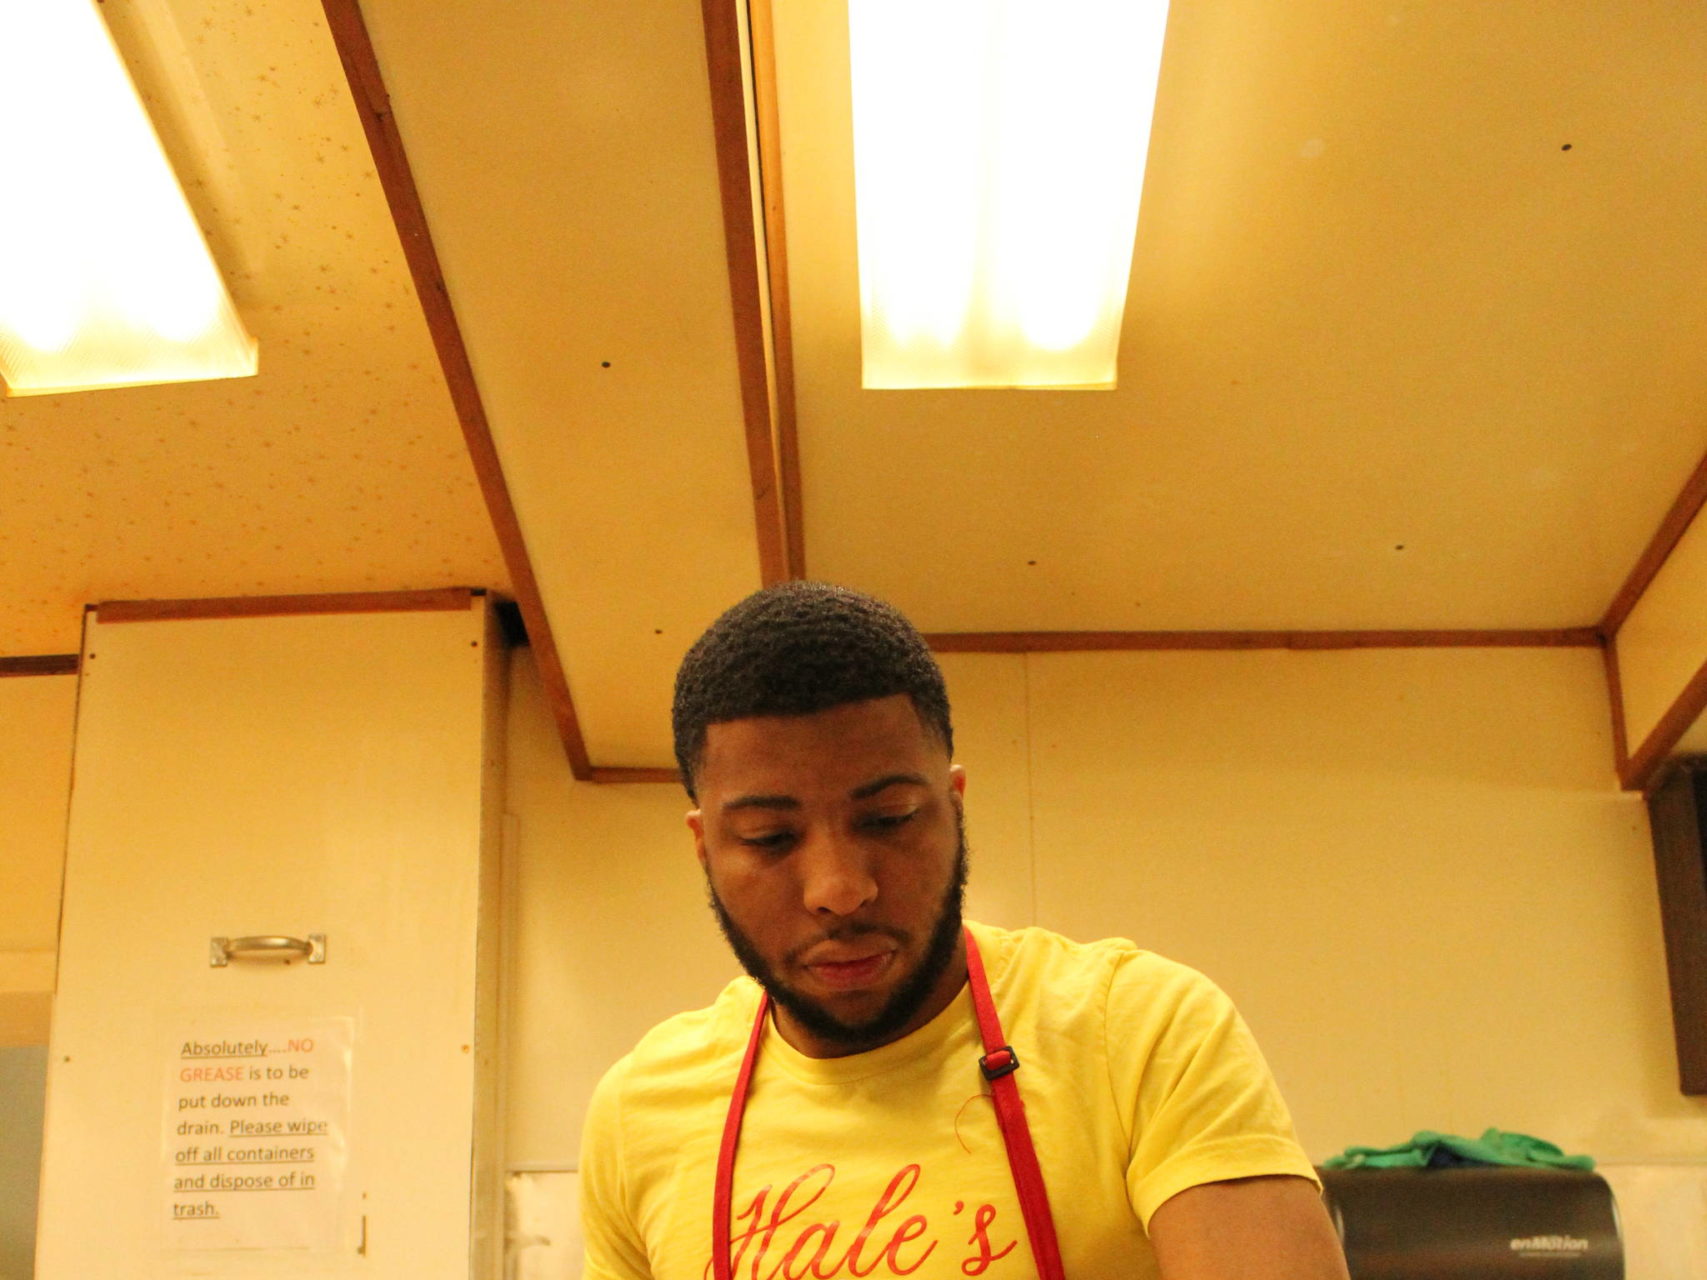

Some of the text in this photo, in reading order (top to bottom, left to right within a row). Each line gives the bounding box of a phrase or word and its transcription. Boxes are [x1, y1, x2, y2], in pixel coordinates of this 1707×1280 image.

[180, 1065, 310, 1083] GREASE is to be
[178, 1092, 290, 1111] put down the
[176, 1118, 328, 1136] drain. Please wipe
[175, 1145, 315, 1162] off all containers
[174, 1171, 315, 1191] and dispose of in
[173, 1201, 220, 1217] trash.
